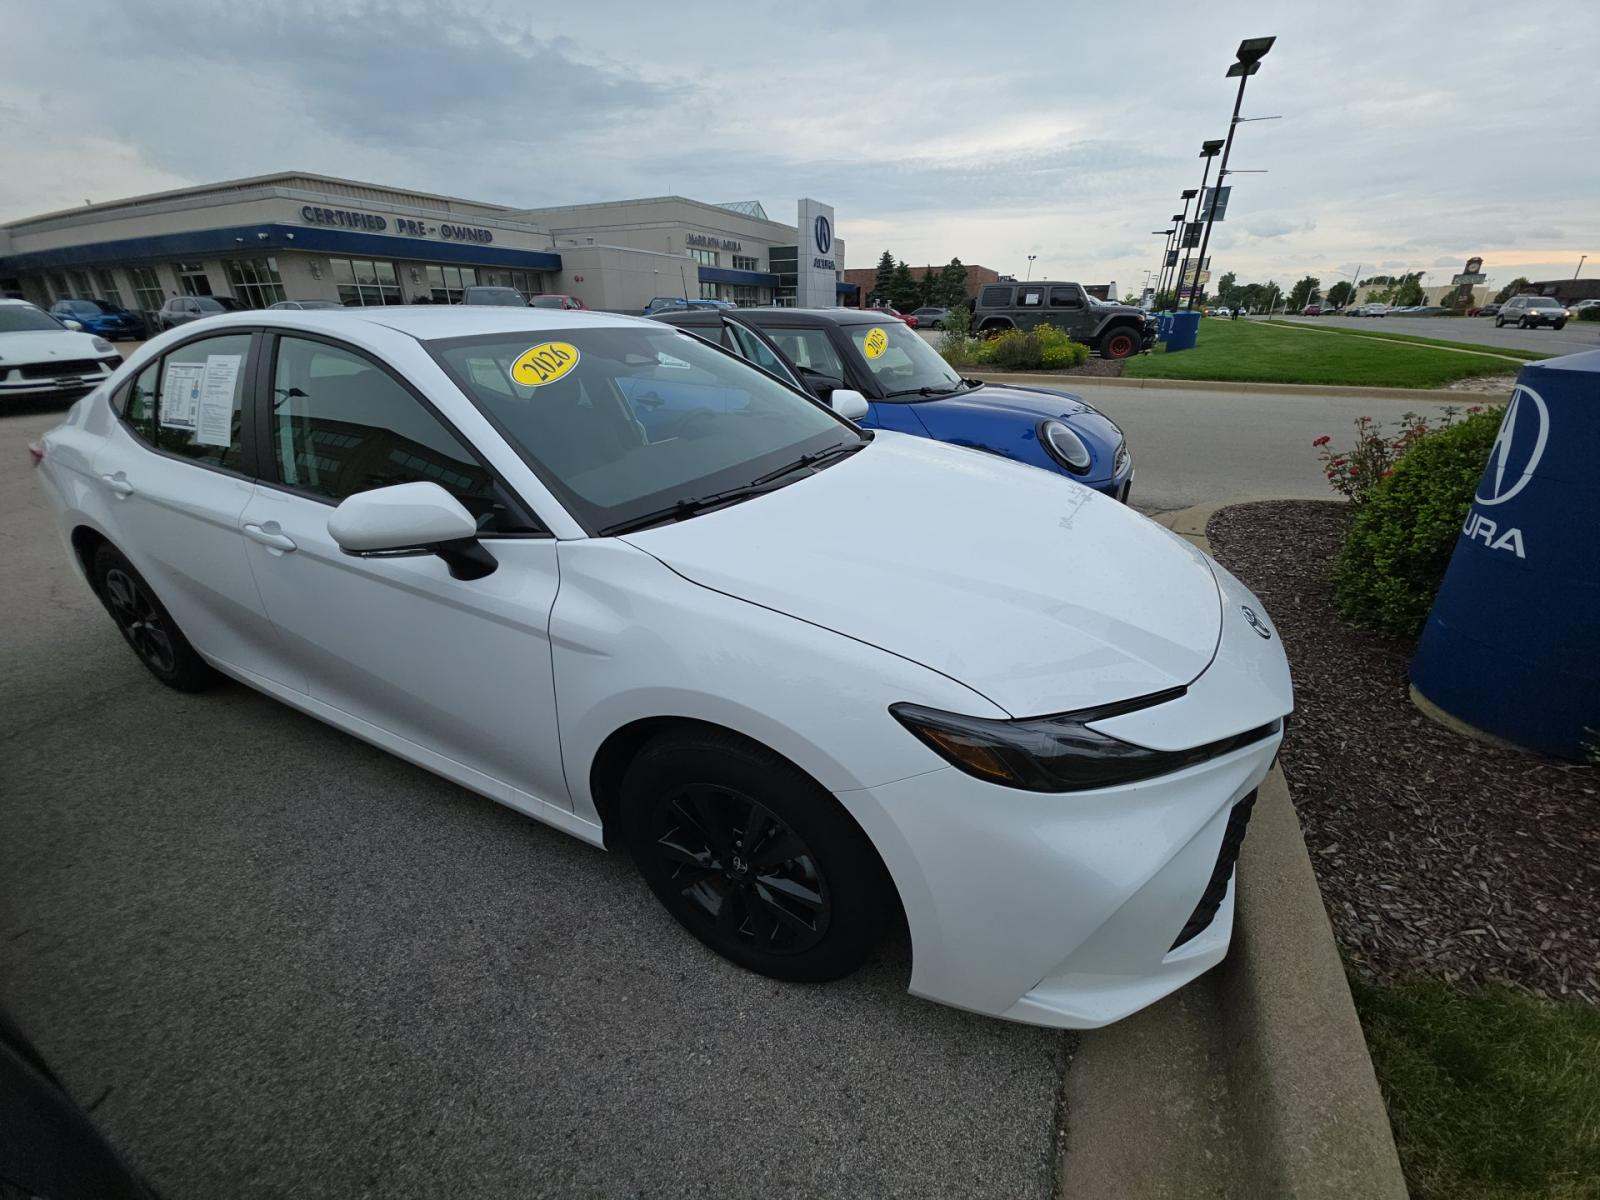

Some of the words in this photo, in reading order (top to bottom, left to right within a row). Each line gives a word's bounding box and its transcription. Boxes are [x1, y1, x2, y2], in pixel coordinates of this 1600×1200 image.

[301, 205, 387, 231] CERTIFIED
[867, 329, 885, 355] 2025
[522, 345, 570, 381] 2026
